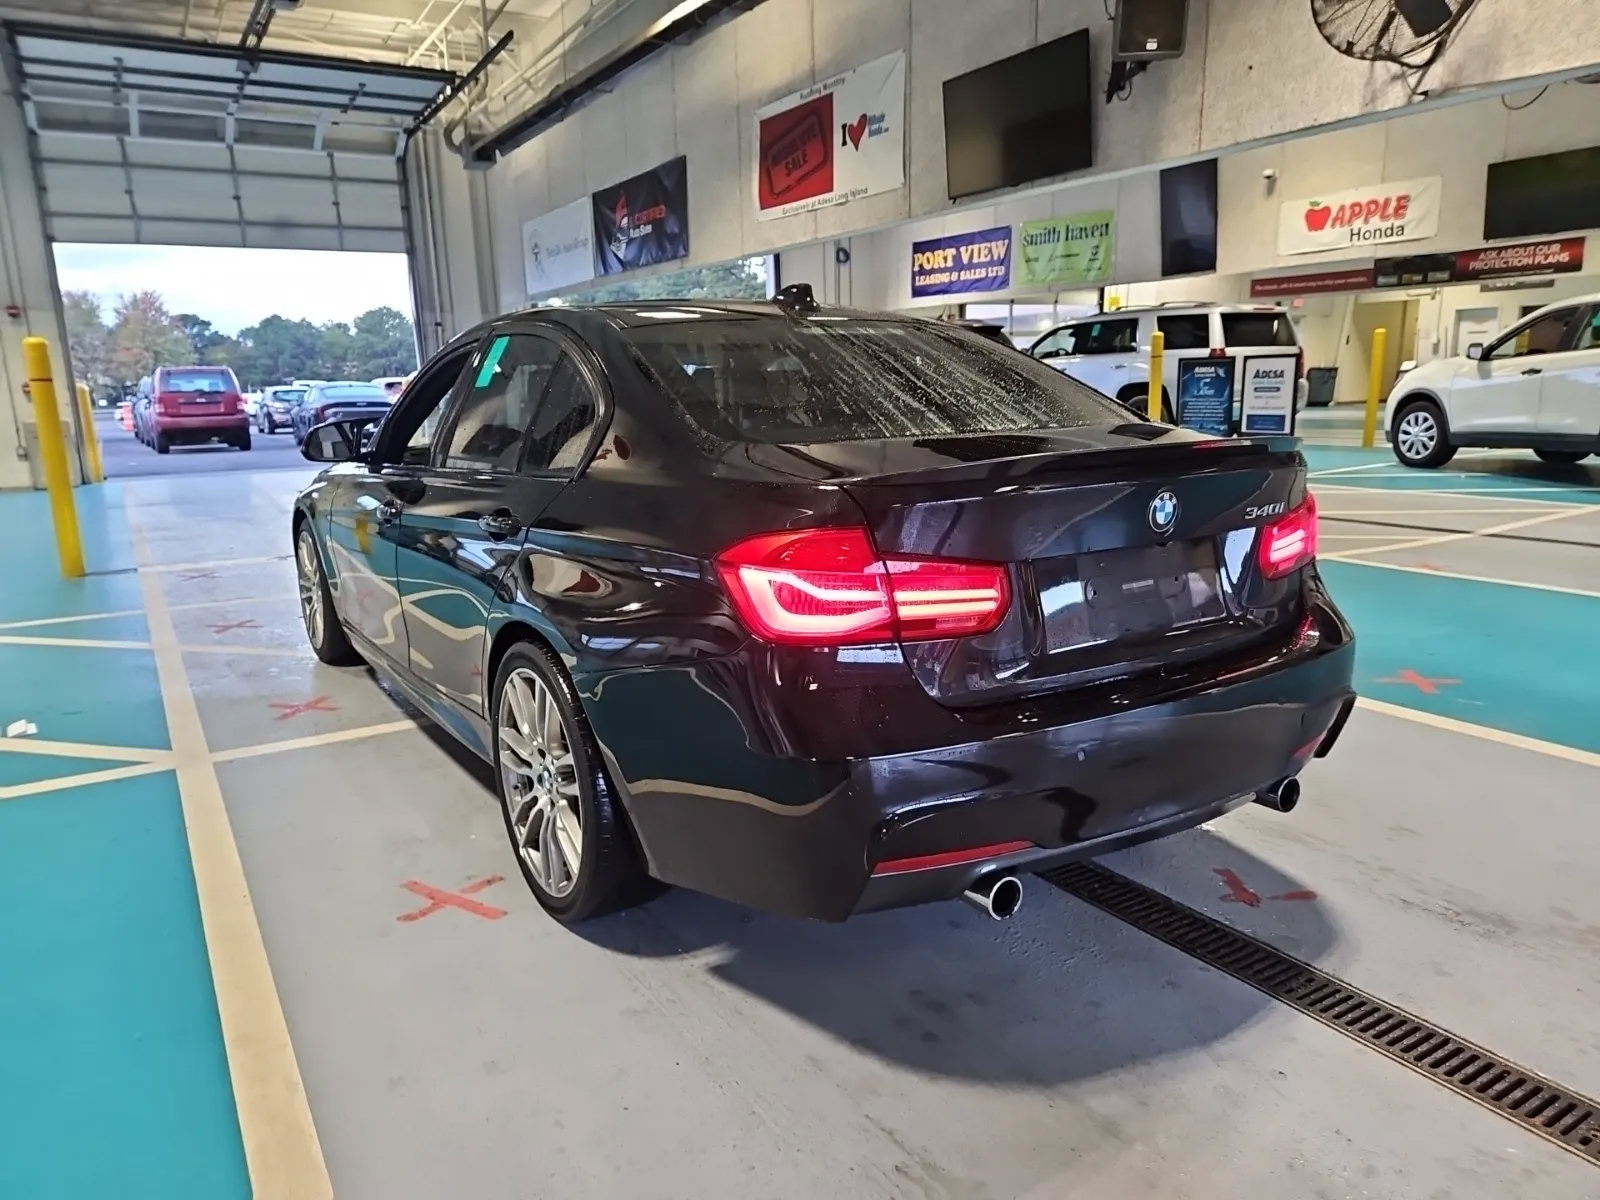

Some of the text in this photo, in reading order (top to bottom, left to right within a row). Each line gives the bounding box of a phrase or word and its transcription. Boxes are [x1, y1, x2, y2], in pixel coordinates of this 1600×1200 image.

[784, 149, 809, 177] SALE
[834, 191, 849, 202] Long
[1330, 195, 1411, 229] APPLE
[1022, 222, 1110, 247] smith haven
[1350, 222, 1405, 242] Honda
[913, 239, 1009, 271] PORT VIEW
[1469, 251, 1570, 271] PROTECTION PLANS
[1478, 243, 1561, 260] ASK ABOUT OUR
[915, 272, 950, 286] LEASING
[960, 266, 986, 280] SALES
[987, 265, 1005, 277] LTD
[1253, 368, 1285, 379] ADESA
